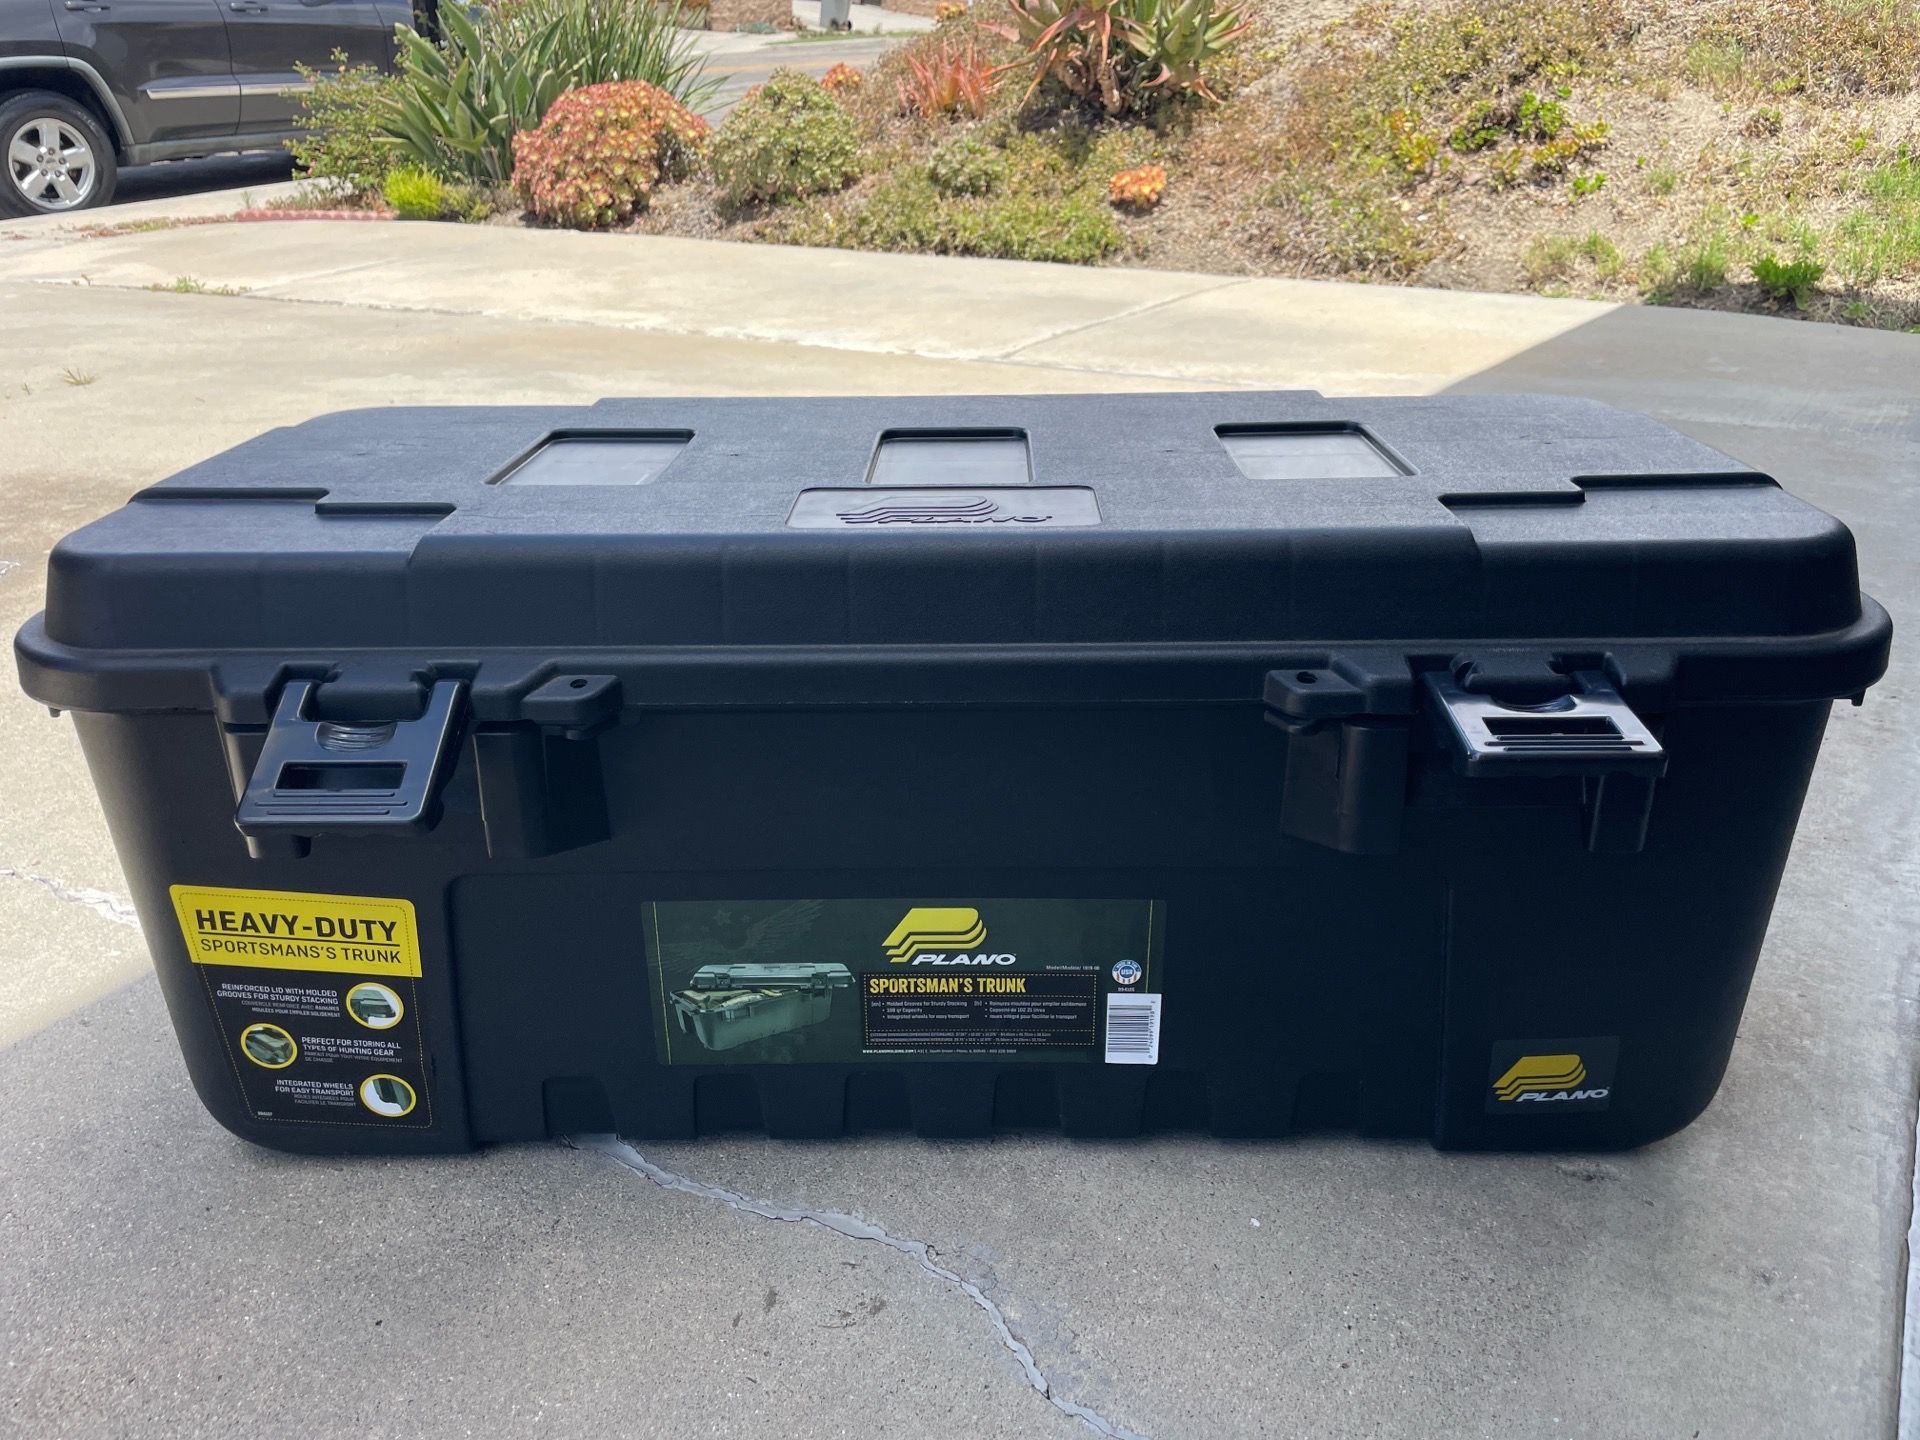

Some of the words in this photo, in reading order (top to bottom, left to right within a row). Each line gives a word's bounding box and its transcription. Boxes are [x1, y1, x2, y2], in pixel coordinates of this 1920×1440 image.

[878, 514, 1052, 524] PLANO
[195, 909, 397, 941] HEAVY-DUTY
[340, 948, 402, 964] TRUNK
[912, 954, 1016, 965] PLANO
[222, 983, 270, 992] REINFORCED
[306, 989, 337, 997] MOLDED
[869, 978, 973, 993] SPORTSMAN'S
[976, 978, 1026, 993] TRUNK
[216, 990, 252, 999] GROOVES
[270, 993, 300, 1002] STURDY
[301, 996, 338, 1004] STACKING
[301, 1037, 335, 1045] PERFECT
[353, 1040, 386, 1048] STORING
[339, 1047, 372, 1055] HUNTING
[276, 1080, 321, 1088] INTEGRATED
[1516, 1089, 1609, 1102] PLANO
